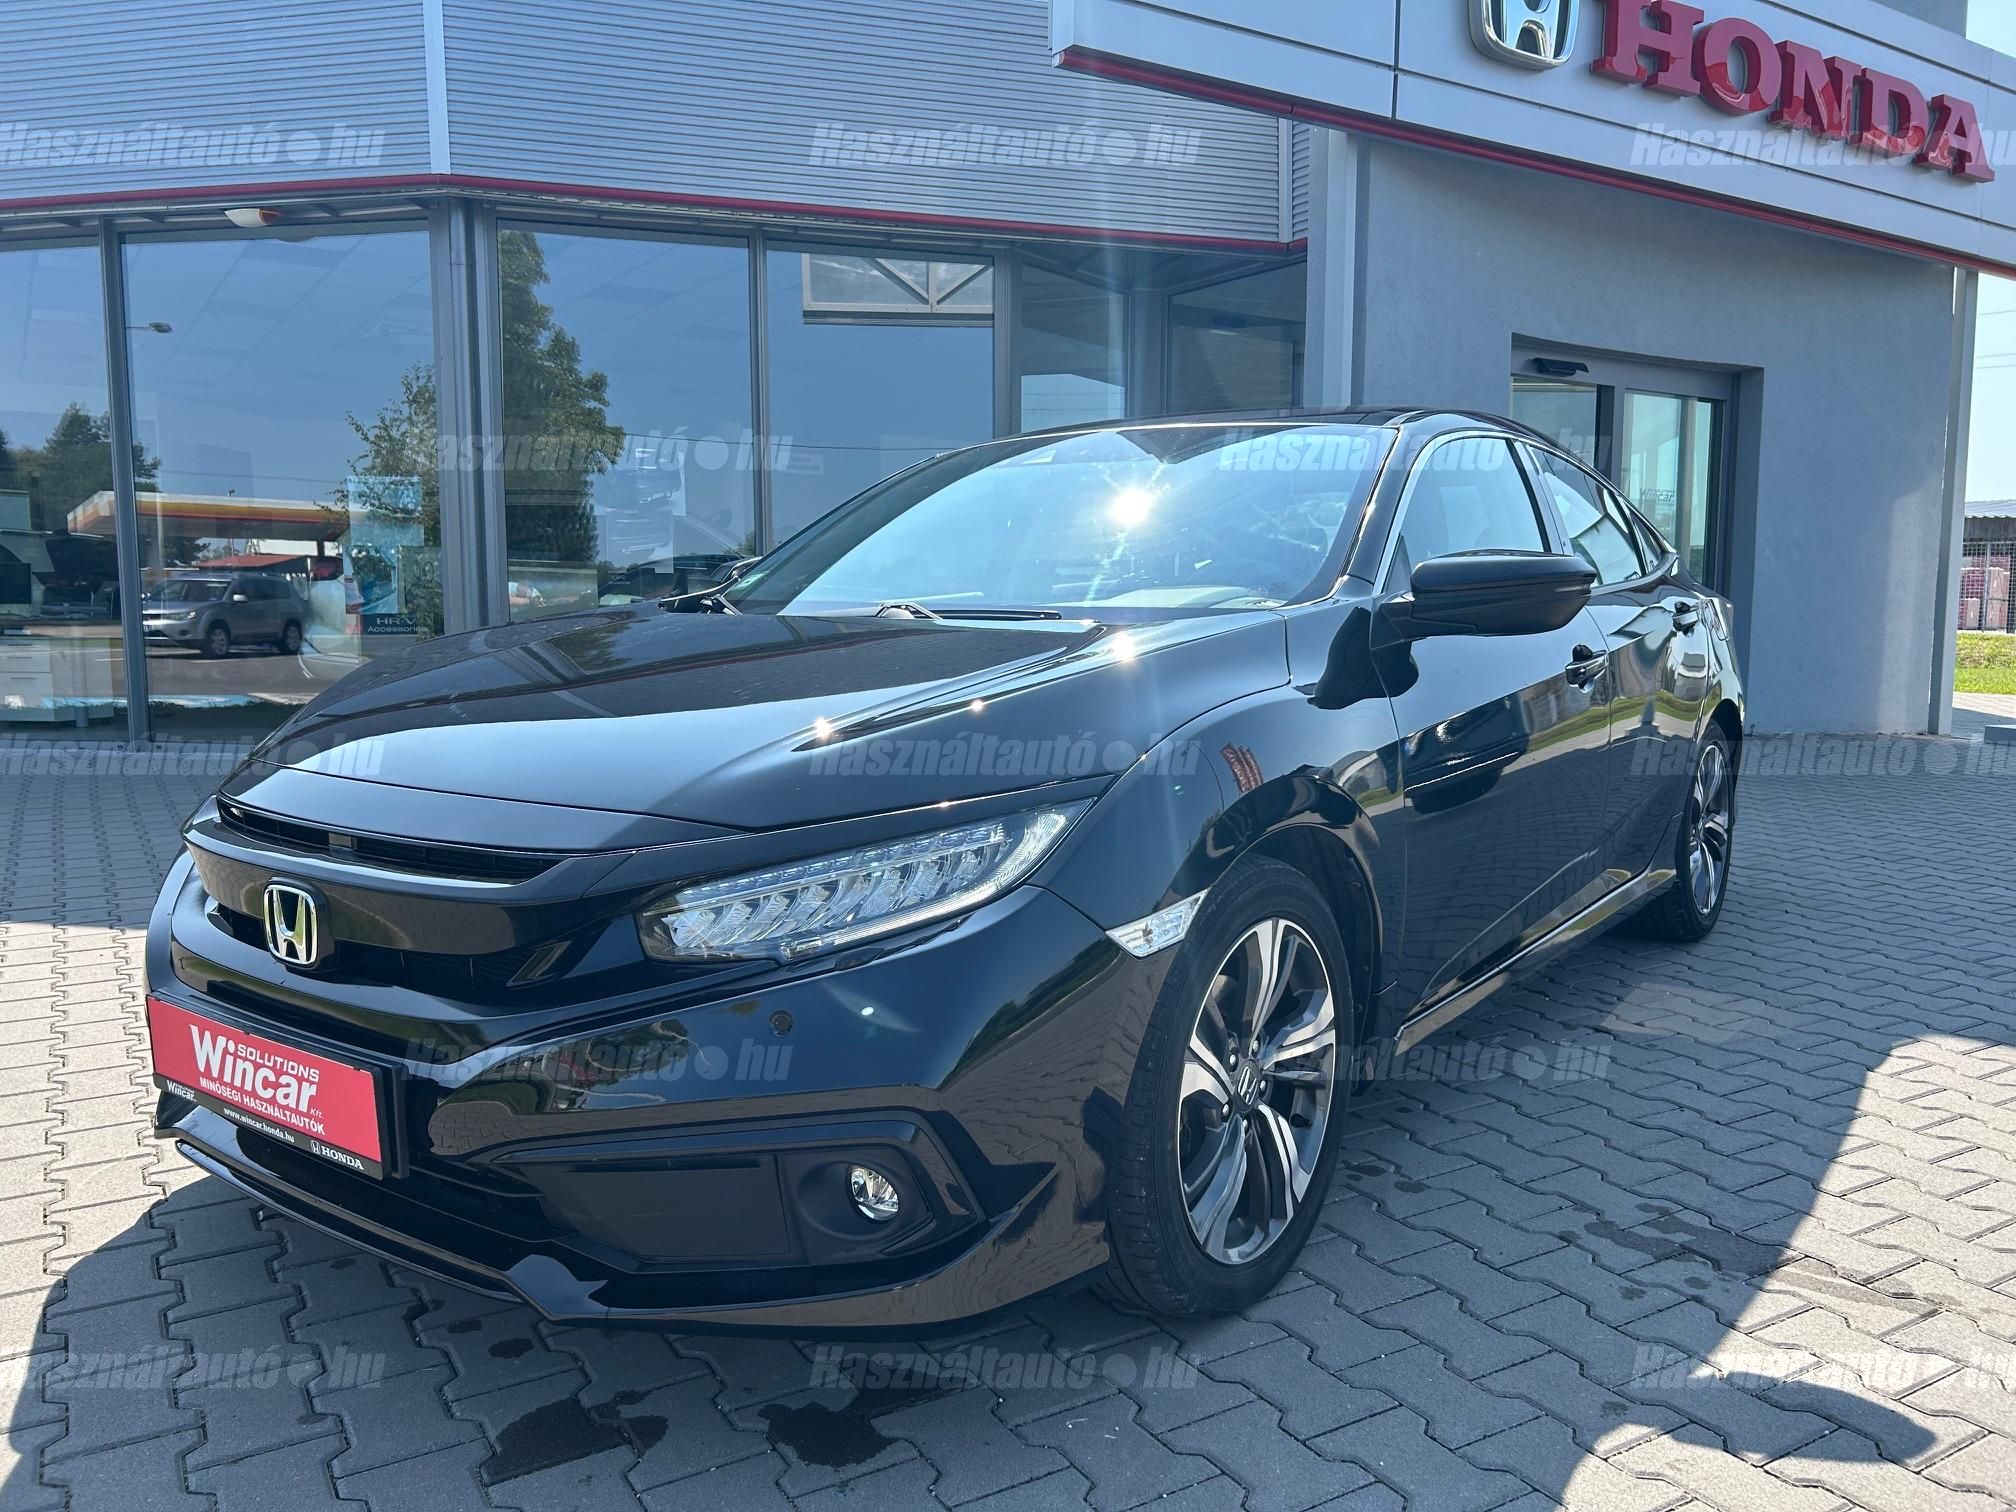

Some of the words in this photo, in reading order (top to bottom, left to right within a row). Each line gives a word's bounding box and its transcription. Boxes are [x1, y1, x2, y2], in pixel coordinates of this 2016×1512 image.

[1593, 0, 1995, 182] HONDA
[189, 1024, 317, 1113] Wincar
[237, 1044, 320, 1082] SOLUTIONS
[166, 1079, 195, 1101] Wincar
[223, 1107, 295, 1143] www.wincar.honda.hu
[243, 1095, 326, 1136] HASZNÁLTAUTÓK
[320, 1145, 365, 1171] HONDA
